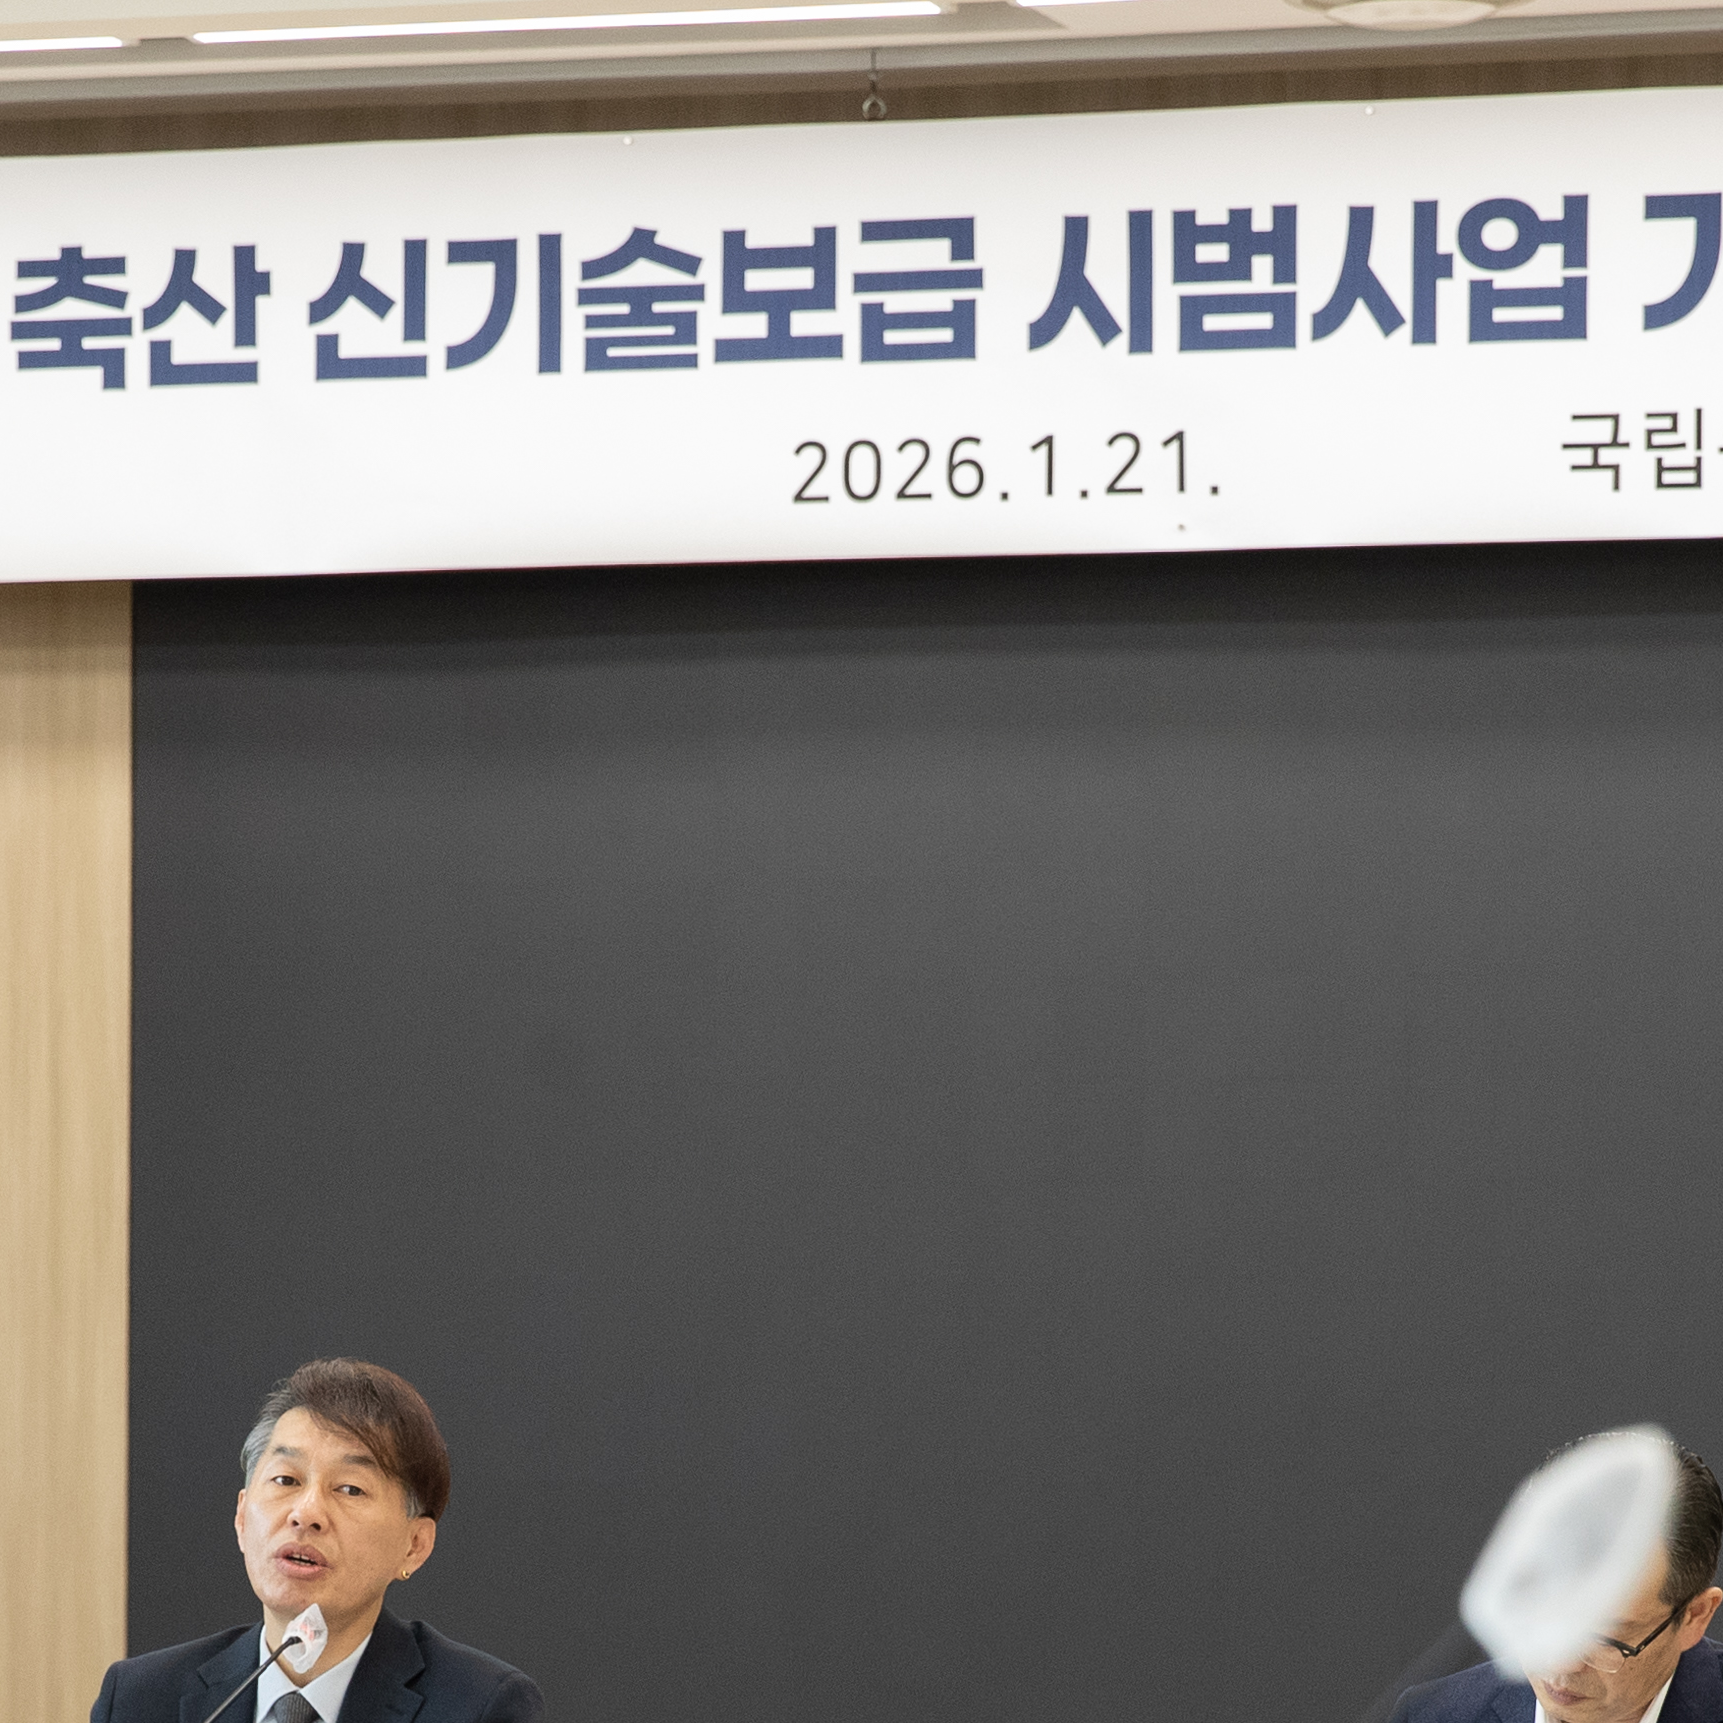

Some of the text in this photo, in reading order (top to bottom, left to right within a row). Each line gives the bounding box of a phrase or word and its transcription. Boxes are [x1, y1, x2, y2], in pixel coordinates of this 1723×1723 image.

[10, 244, 273, 391] 축산
[308, 215, 985, 382] 신기술보급
[1028, 193, 1589, 355] 시범사업
[792, 430, 1219, 504] 2026.1.21.
